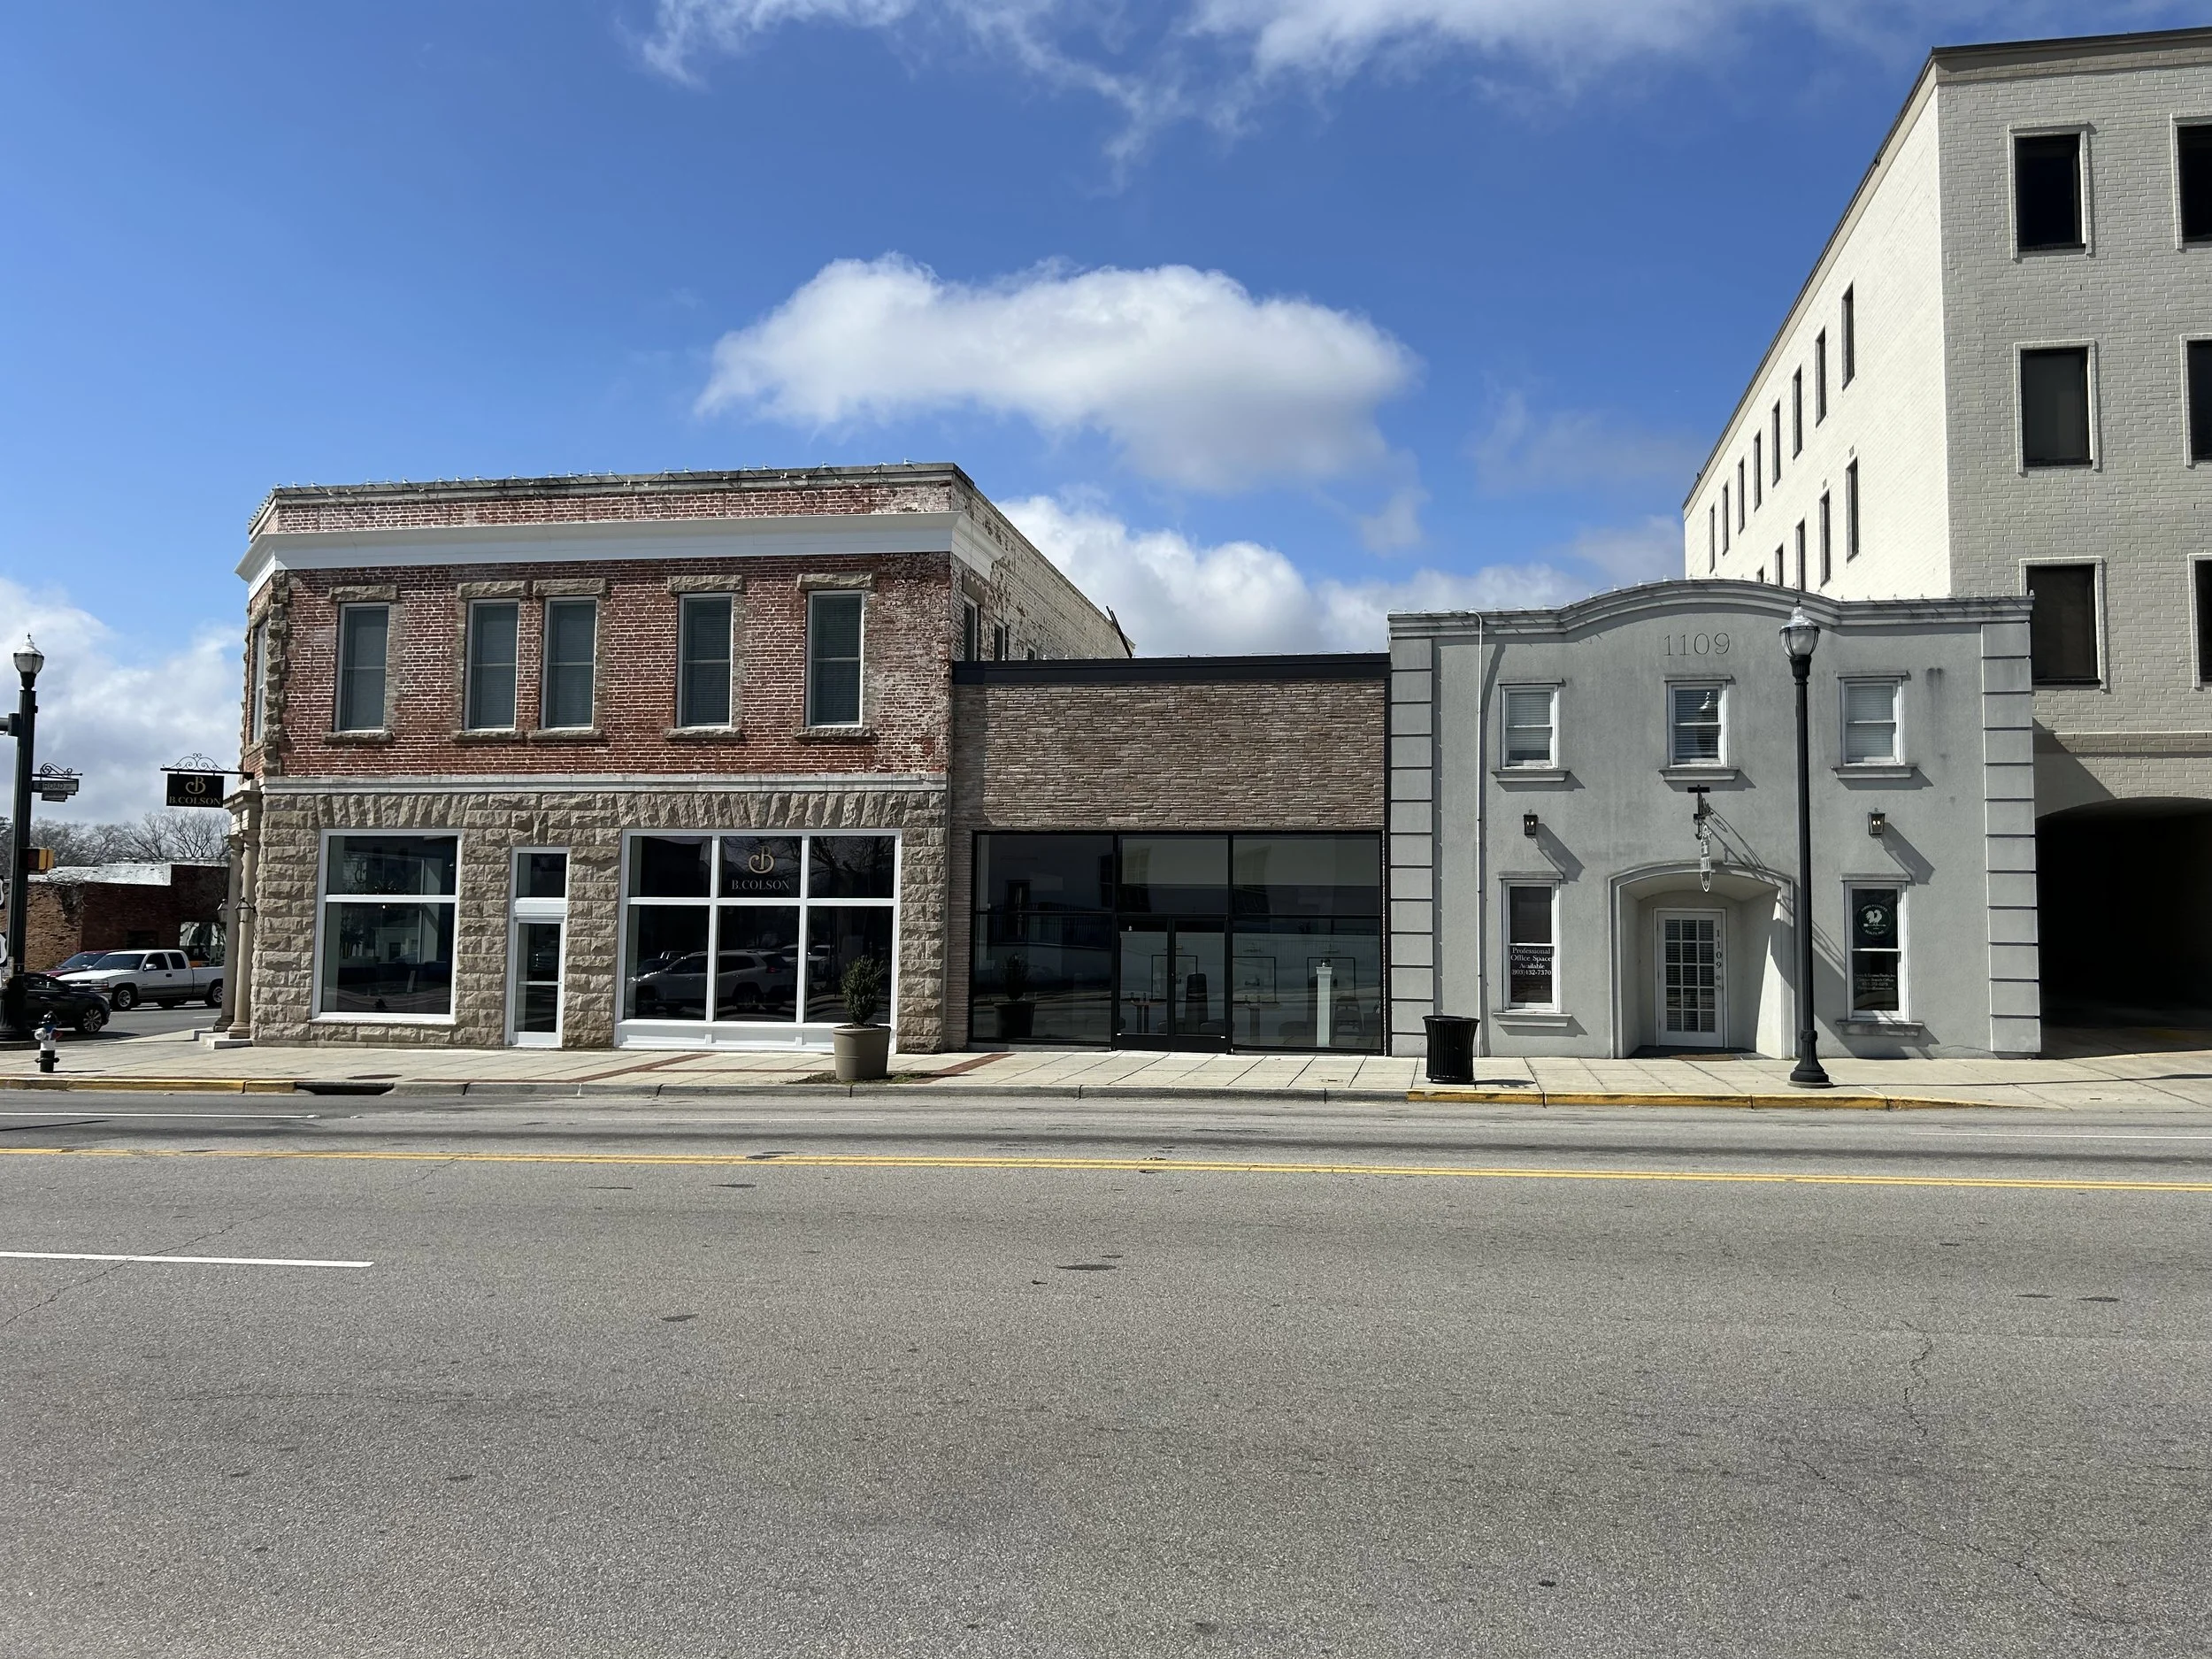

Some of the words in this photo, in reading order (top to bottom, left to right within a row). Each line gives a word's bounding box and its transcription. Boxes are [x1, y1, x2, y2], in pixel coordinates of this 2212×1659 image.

[1663, 633, 1730, 656] 1109
[169, 795, 221, 805] B.COLSON
[731, 879, 789, 890] B.COLSON
